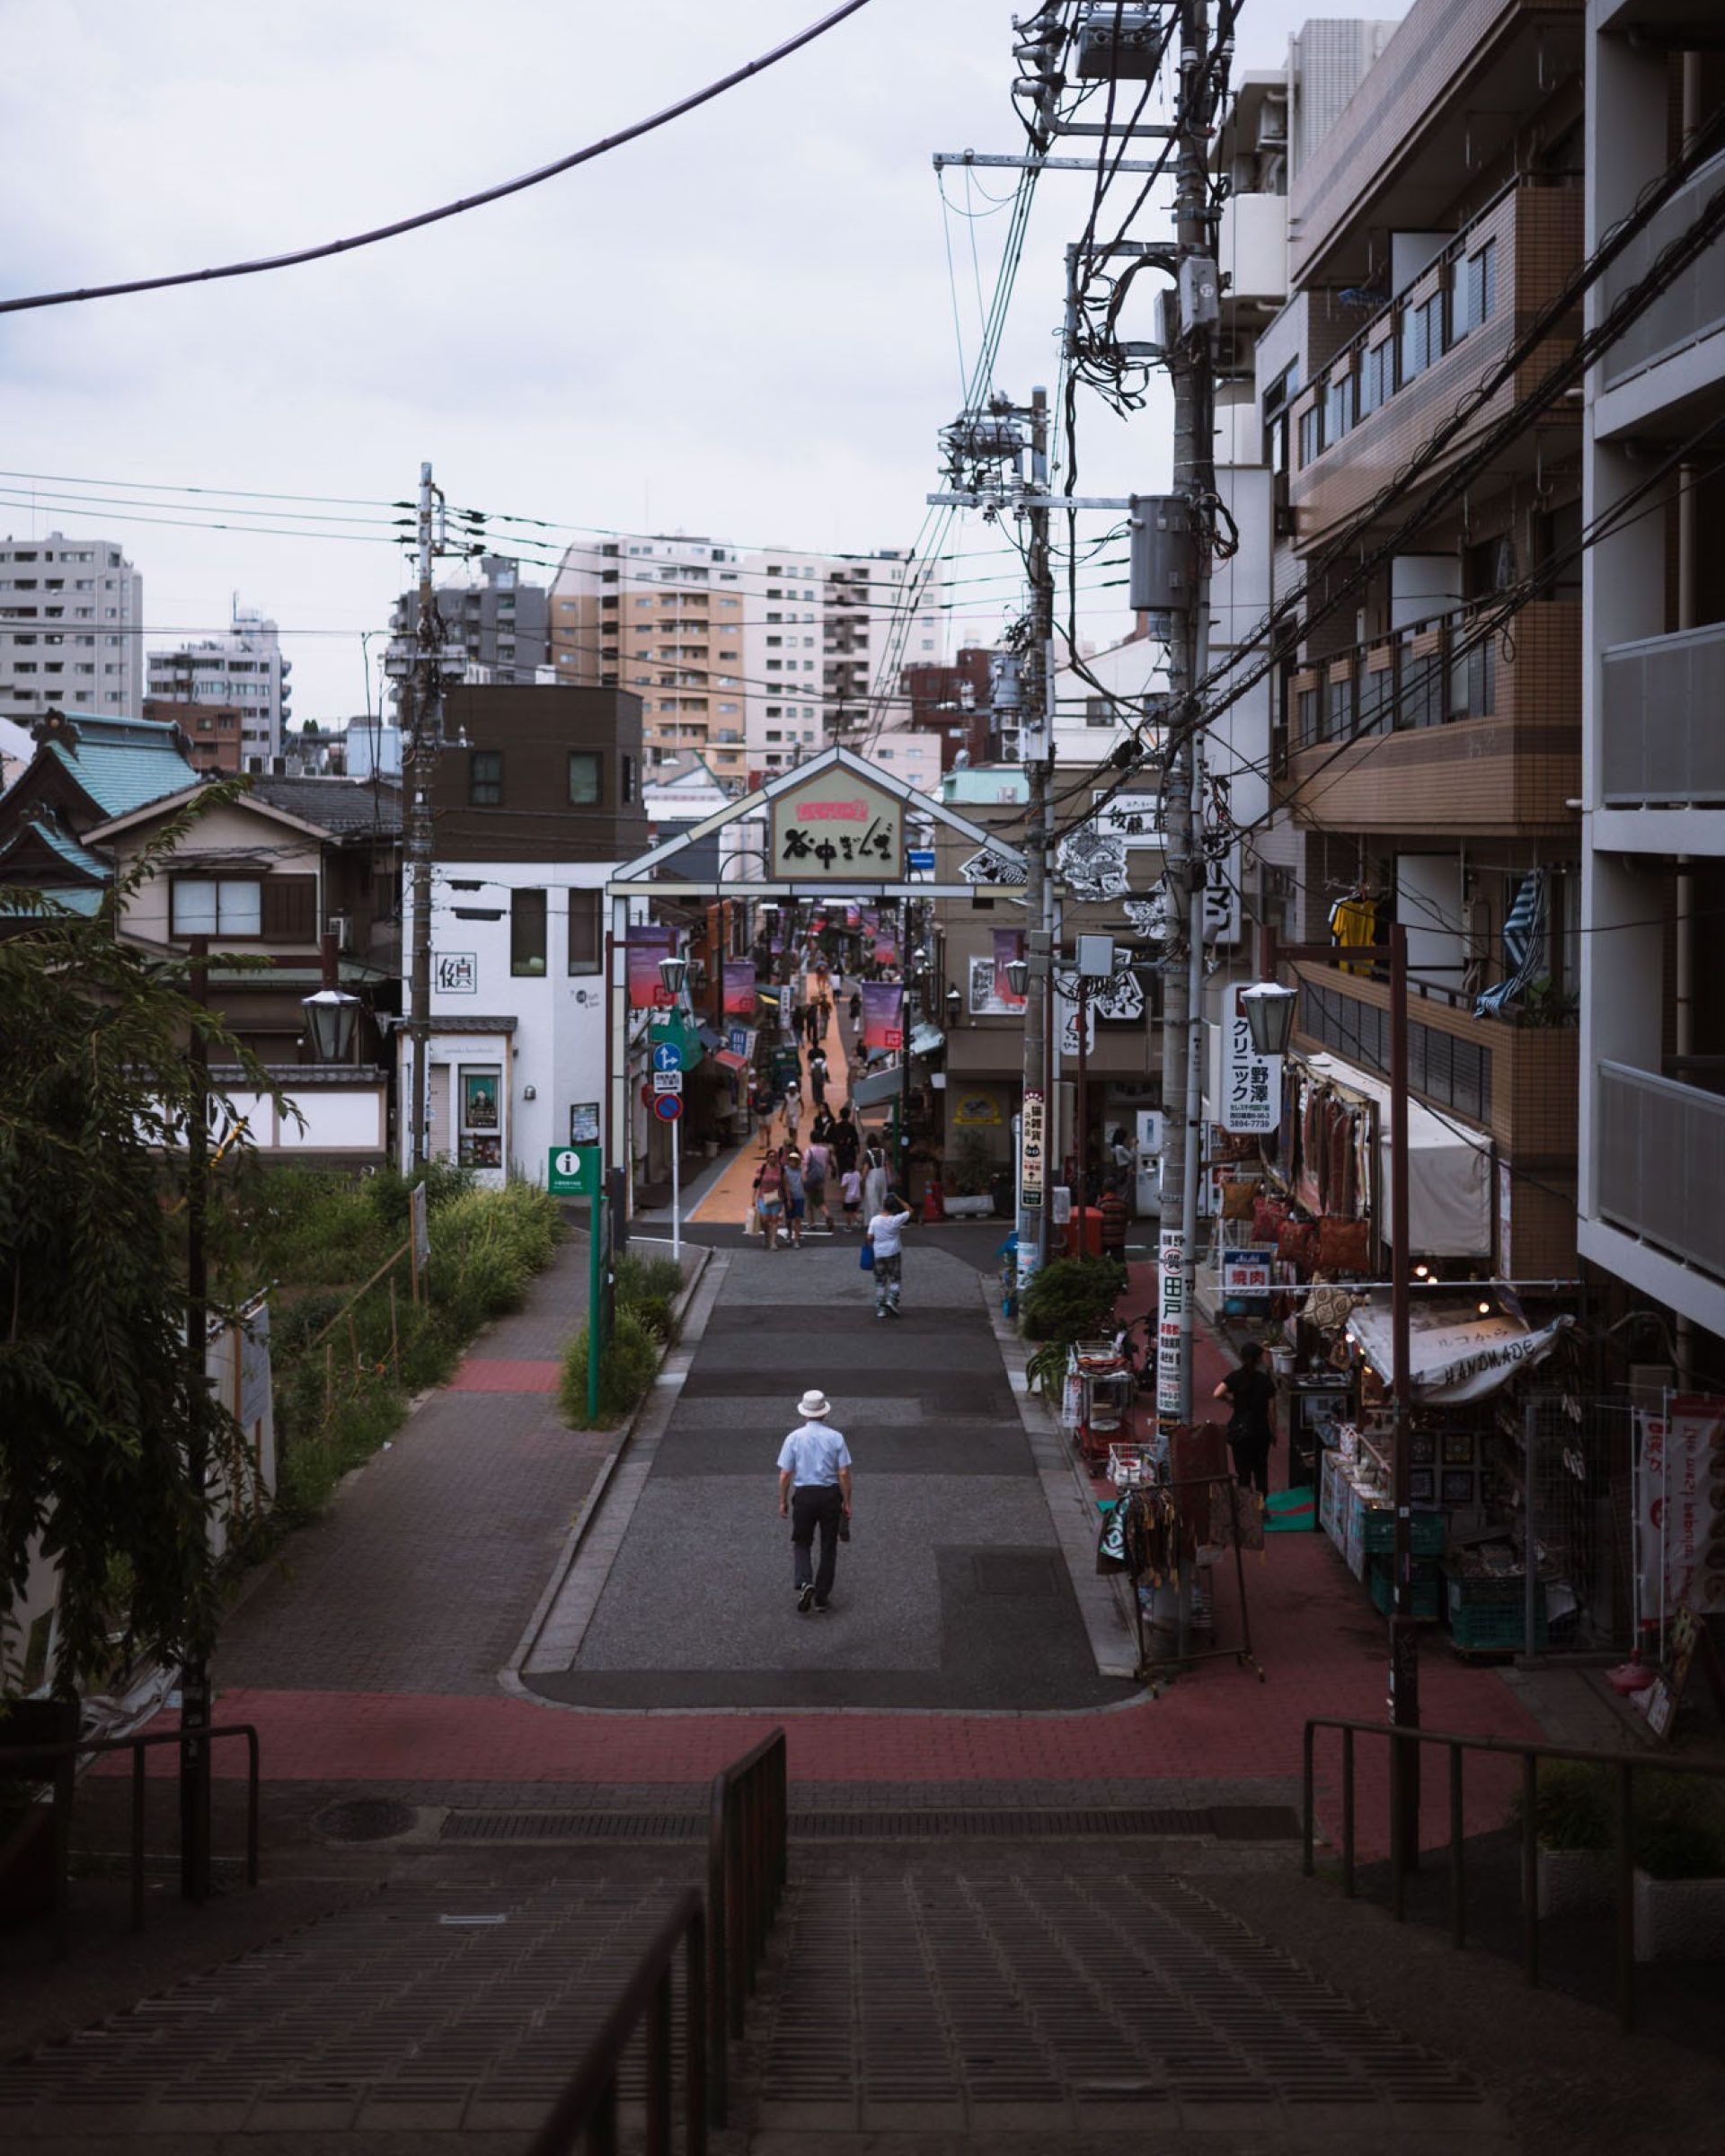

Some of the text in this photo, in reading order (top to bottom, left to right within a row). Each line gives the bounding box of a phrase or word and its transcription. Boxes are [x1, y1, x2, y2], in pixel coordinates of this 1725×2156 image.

[1232, 1020, 1250, 1102] クリニック
[1163, 1276, 1182, 1320] 田戸
